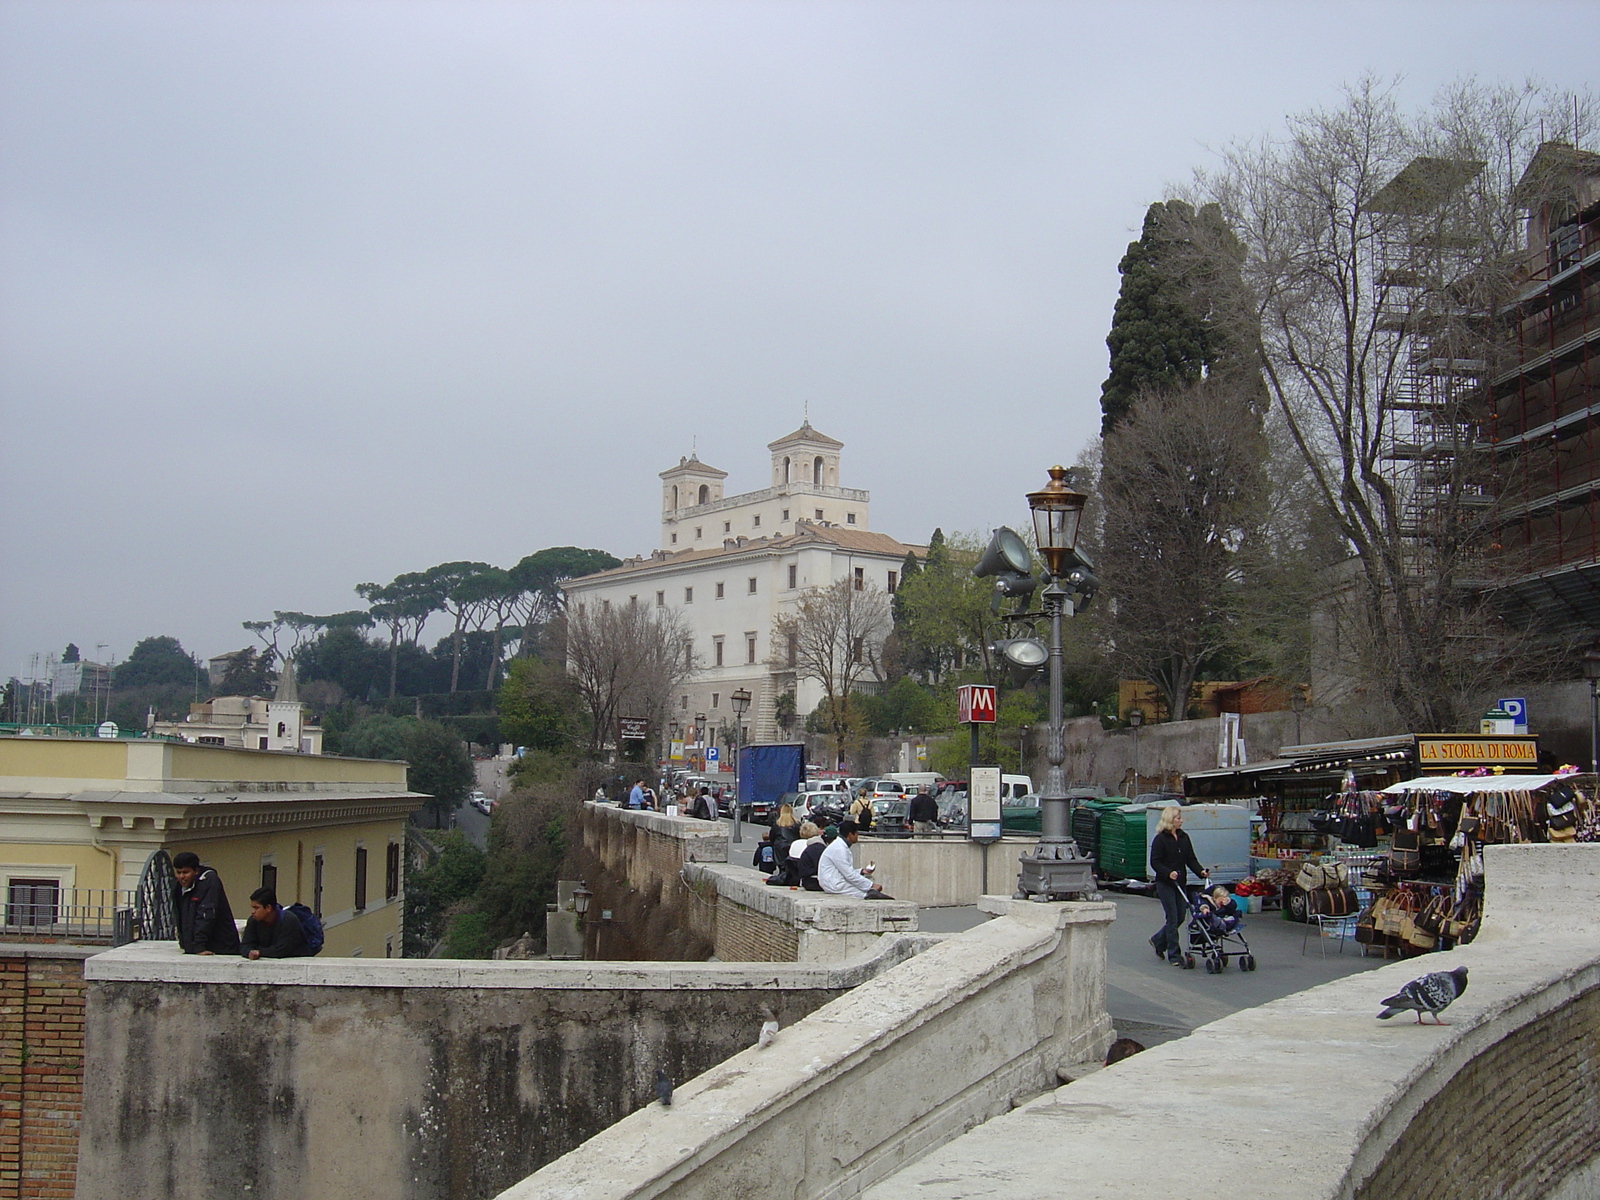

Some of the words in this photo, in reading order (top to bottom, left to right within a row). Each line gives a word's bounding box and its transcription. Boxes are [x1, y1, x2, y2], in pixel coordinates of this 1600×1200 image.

[972, 688, 993, 711] M
[708, 748, 717, 760] P
[1420, 743, 1437, 759] LA
[1441, 743, 1486, 759] STORIA
[1488, 743, 1500, 759] DI
[1502, 743, 1536, 759] ROMA
